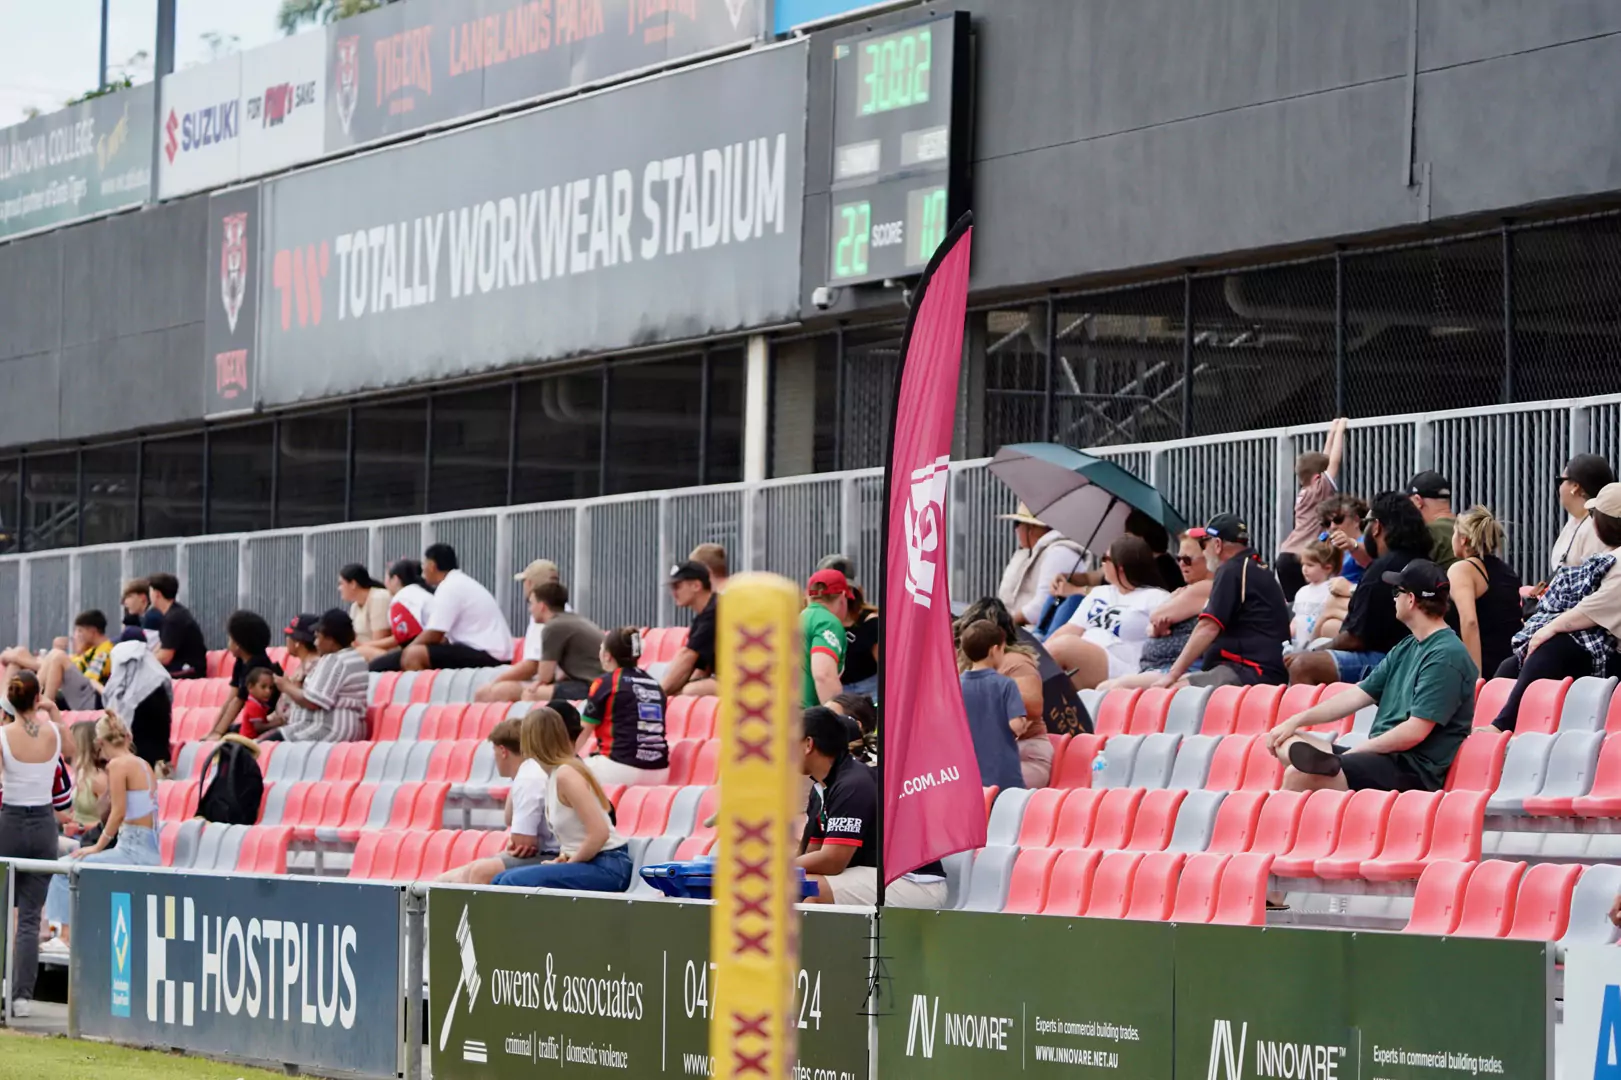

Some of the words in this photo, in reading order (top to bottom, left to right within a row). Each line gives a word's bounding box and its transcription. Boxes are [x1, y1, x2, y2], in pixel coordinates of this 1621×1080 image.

[449, 0, 551, 77] LANGLANDS
[48, 117, 94, 166] COLLEGE
[182, 99, 239, 152] SUZUKI
[335, 213, 444, 320] TOTALLY
[448, 169, 633, 298] WORKWEAR
[640, 133, 787, 260] STADIUM
[835, 202, 871, 277] 22
[871, 221, 903, 247] SCORE
[899, 766, 960, 799] .COM.AU
[827, 817, 862, 828] SUPER
[201, 914, 358, 1030] HOSTPLUS
[491, 968, 540, 1010] owens
[543, 952, 559, 1012] &
[563, 964, 643, 1021] associates
[505, 1031, 532, 1057] criminal
[538, 1036, 559, 1060] traffic
[566, 1038, 598, 1066] domestic
[598, 1043, 628, 1069] violence
[1035, 1016, 1057, 1035] Experts
[1057, 1018, 1064, 1034] in
[1064, 1020, 1096, 1037] commercial
[1096, 1022, 1119, 1043] building
[1120, 1024, 1140, 1041] trades.
[1035, 1045, 1119, 1069] WWW.INNOVARE.NET.AU
[1373, 1045, 1399, 1067] Experts
[1399, 1047, 1406, 1064] in
[1406, 1050, 1448, 1069] commercial
[1448, 1051, 1478, 1076] building
[1478, 1055, 1505, 1075] trades.
